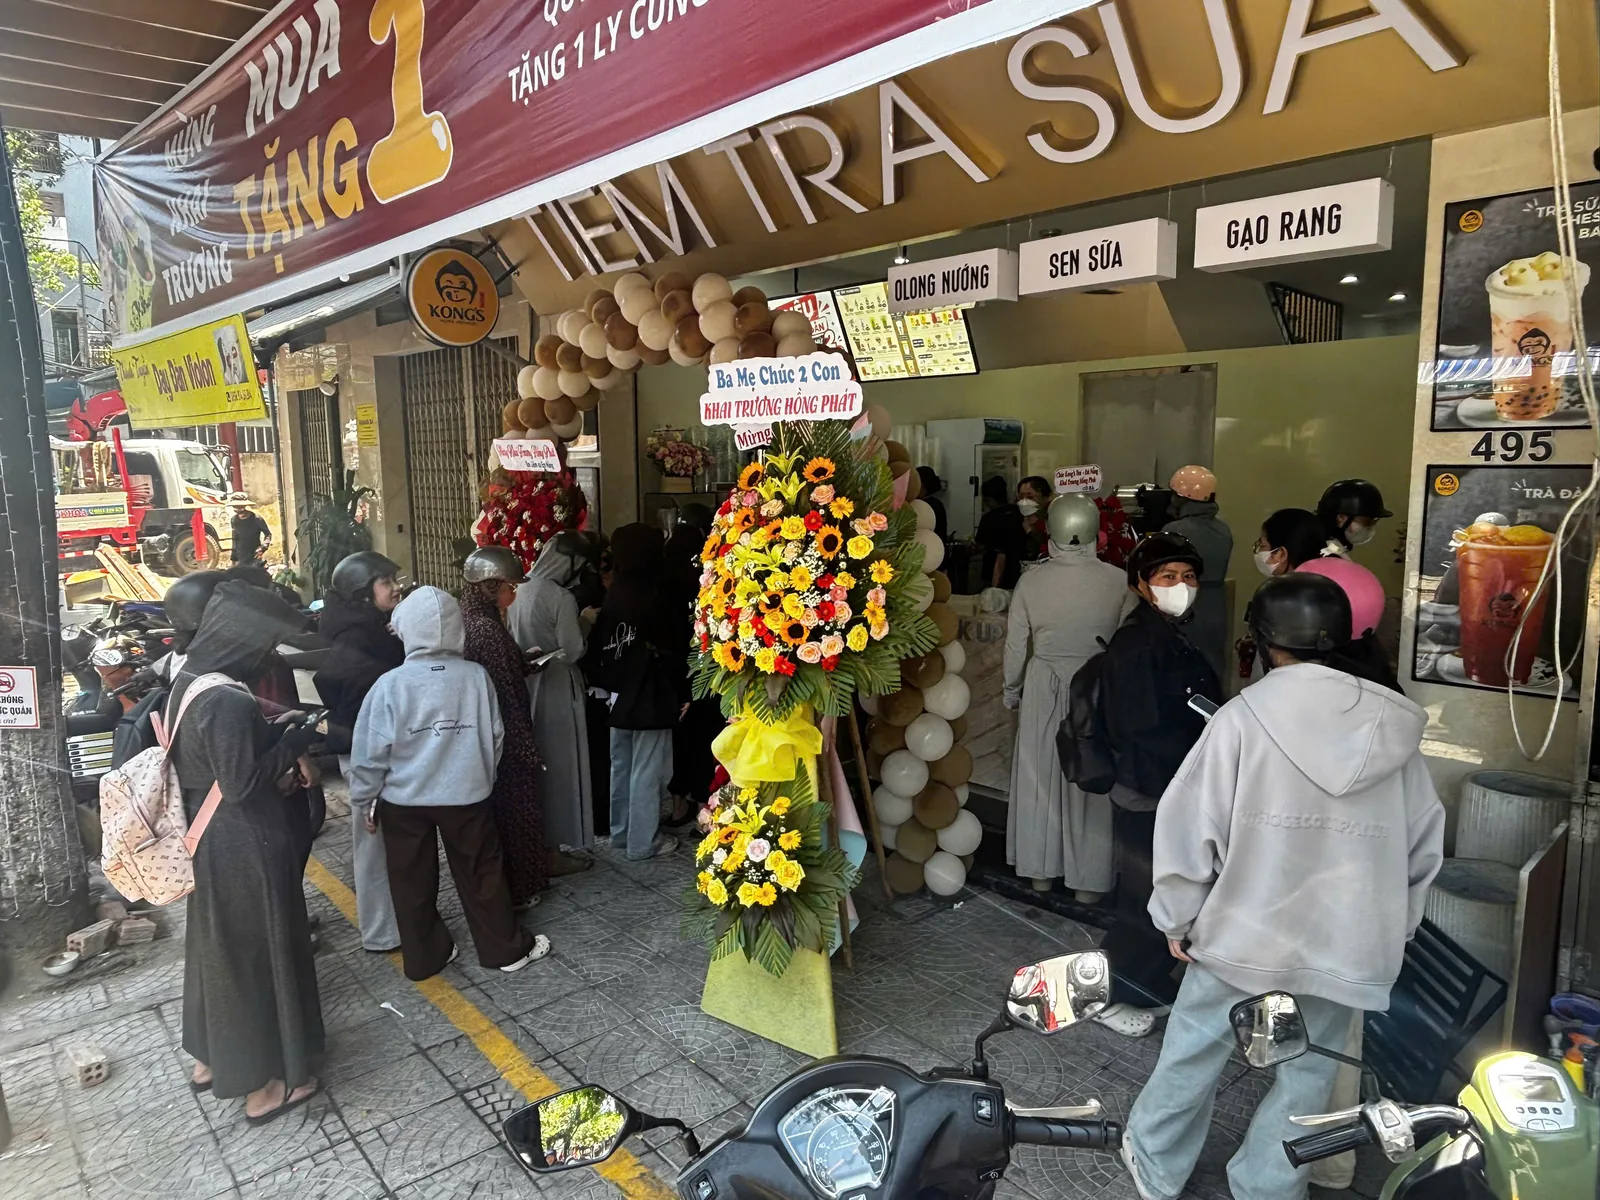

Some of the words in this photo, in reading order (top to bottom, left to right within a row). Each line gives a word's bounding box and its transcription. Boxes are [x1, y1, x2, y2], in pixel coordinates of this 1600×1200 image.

[244, 0, 341, 138] MUA
[508, 43, 565, 106] TẶNG
[573, 31, 585, 69] 1
[593, 10, 623, 61] LY
[367, 0, 453, 204] 1
[232, 118, 364, 273] TẶNG
[1574, 196, 1600, 212] SỮ
[1226, 215, 1270, 252] GẠO
[1280, 203, 1342, 241] RANG
[1049, 247, 1080, 279] SEN
[1088, 240, 1123, 271] SỮA
[895, 273, 936, 302] OLONG
[942, 263, 989, 294] NƯỚNG
[428, 304, 486, 322] KONG'S
[716, 369, 733, 389] Ba
[736, 367, 756, 392] Mẹ
[759, 363, 795, 386] Chúc
[799, 365, 808, 383] 2
[811, 361, 841, 381] Con
[704, 401, 732, 420] KHAI
[735, 395, 782, 418] TRƯƠNG
[784, 388, 818, 415] HỒNG
[821, 388, 857, 413] PHÁT
[737, 428, 772, 450] Mừng
[1471, 431, 1553, 463] 495
[1523, 486, 1555, 499] TRÀ
[0, 694, 24, 704] HÔNG
